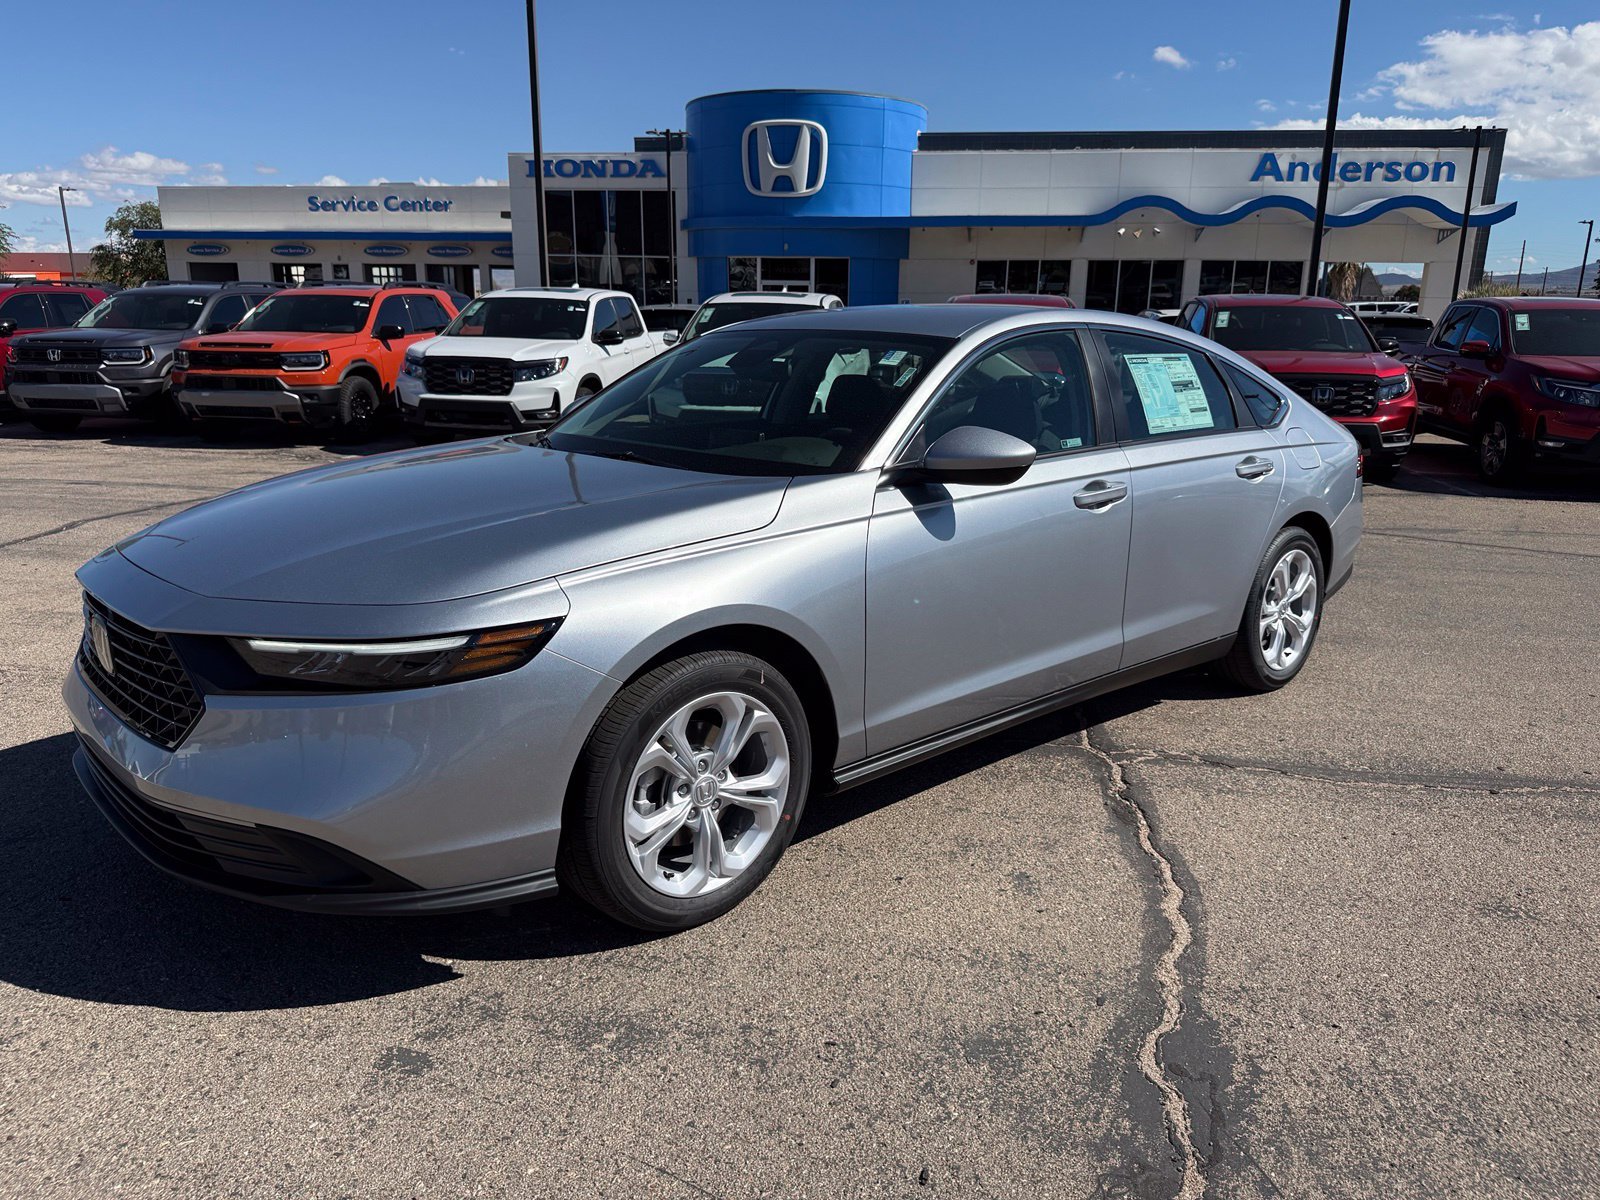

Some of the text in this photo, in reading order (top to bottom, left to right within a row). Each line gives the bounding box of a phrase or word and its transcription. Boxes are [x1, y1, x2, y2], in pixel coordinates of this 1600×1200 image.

[525, 158, 667, 178] HONDA
[1250, 152, 1457, 183] Anderson
[307, 194, 453, 212] Service Center
